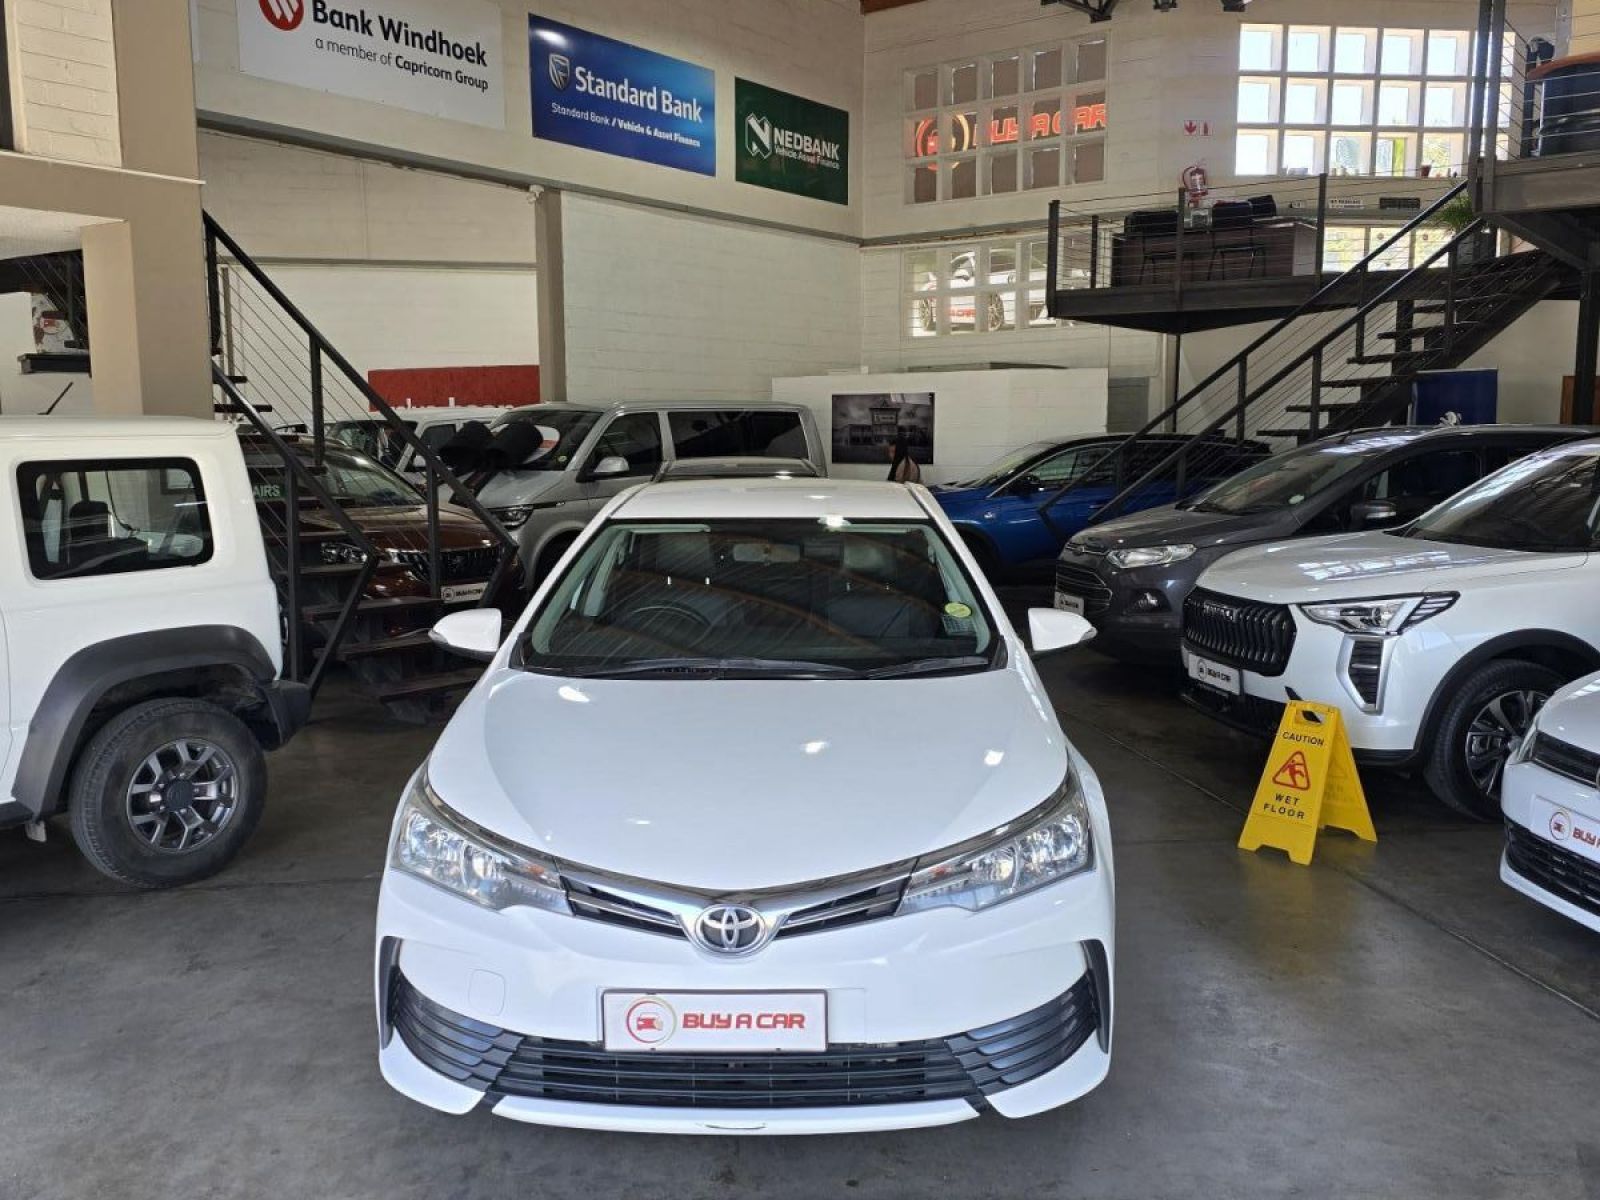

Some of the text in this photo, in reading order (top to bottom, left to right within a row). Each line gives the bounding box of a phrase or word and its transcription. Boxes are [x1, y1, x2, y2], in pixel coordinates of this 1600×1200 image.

[312, 0, 488, 67] Bank Windhoek
[315, 38, 489, 93] a member of Capricorn Group
[575, 66, 703, 123] Standard Bank
[551, 102, 589, 121] Standard
[590, 111, 610, 126] Bank
[774, 127, 840, 161] NEDBANK
[1282, 731, 1325, 746] CAUTION
[1263, 803, 1305, 819] FLOOR
[1275, 793, 1300, 805] WET
[682, 1013, 806, 1029] BUY A CAR
